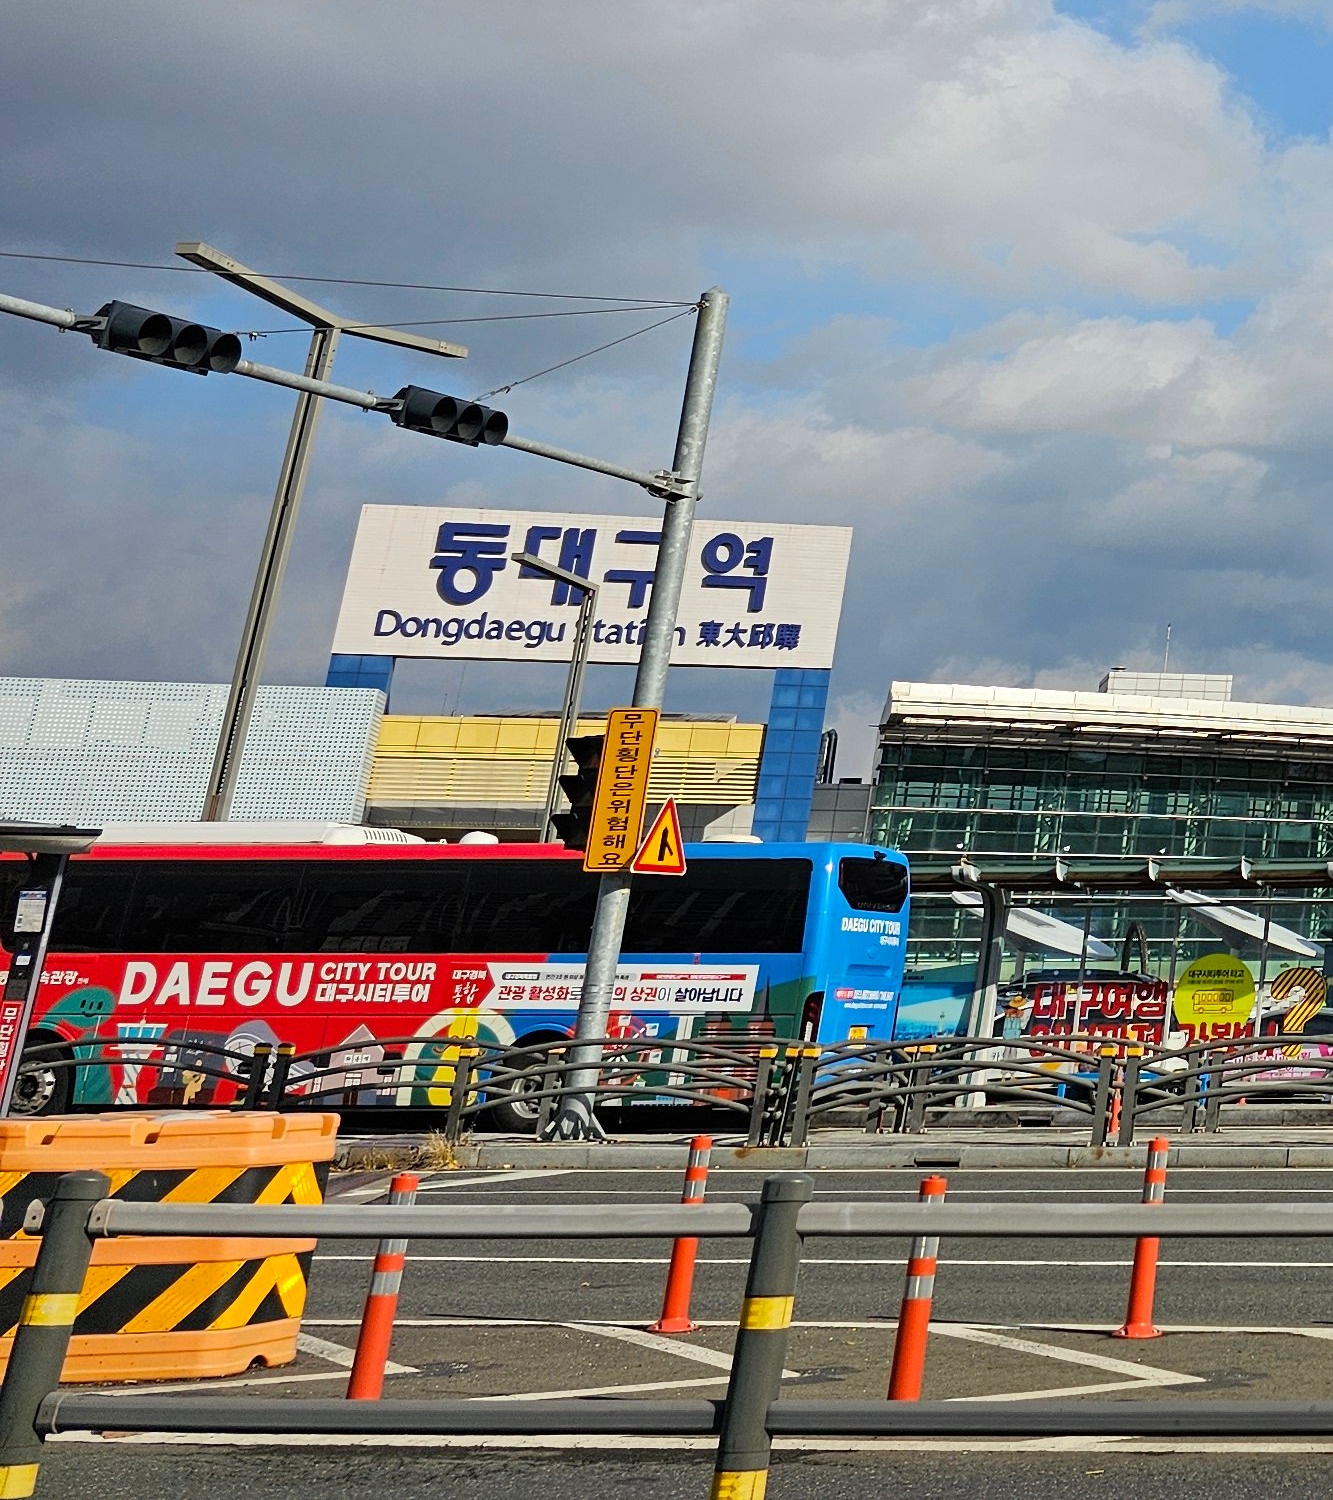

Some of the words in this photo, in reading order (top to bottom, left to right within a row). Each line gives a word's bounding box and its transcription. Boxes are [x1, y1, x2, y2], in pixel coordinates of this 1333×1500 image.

[429, 521, 774, 613] 동대구역
[373, 609, 566, 647] Dongdaegu
[575, 617, 686, 646] tatin
[841, 917, 868, 932] DAEGU
[869, 918, 885, 934] CITY
[118, 961, 315, 1006] DAEGU
[320, 962, 372, 981] CITY
[377, 962, 437, 981] TOUR
[451, 969, 488, 980] 대구경북
[315, 983, 432, 1004] 대구시티투어
[497, 985, 527, 1001] 관광
[630, 986, 671, 1002] 상권이
[674, 987, 744, 1003] 살아납니다
